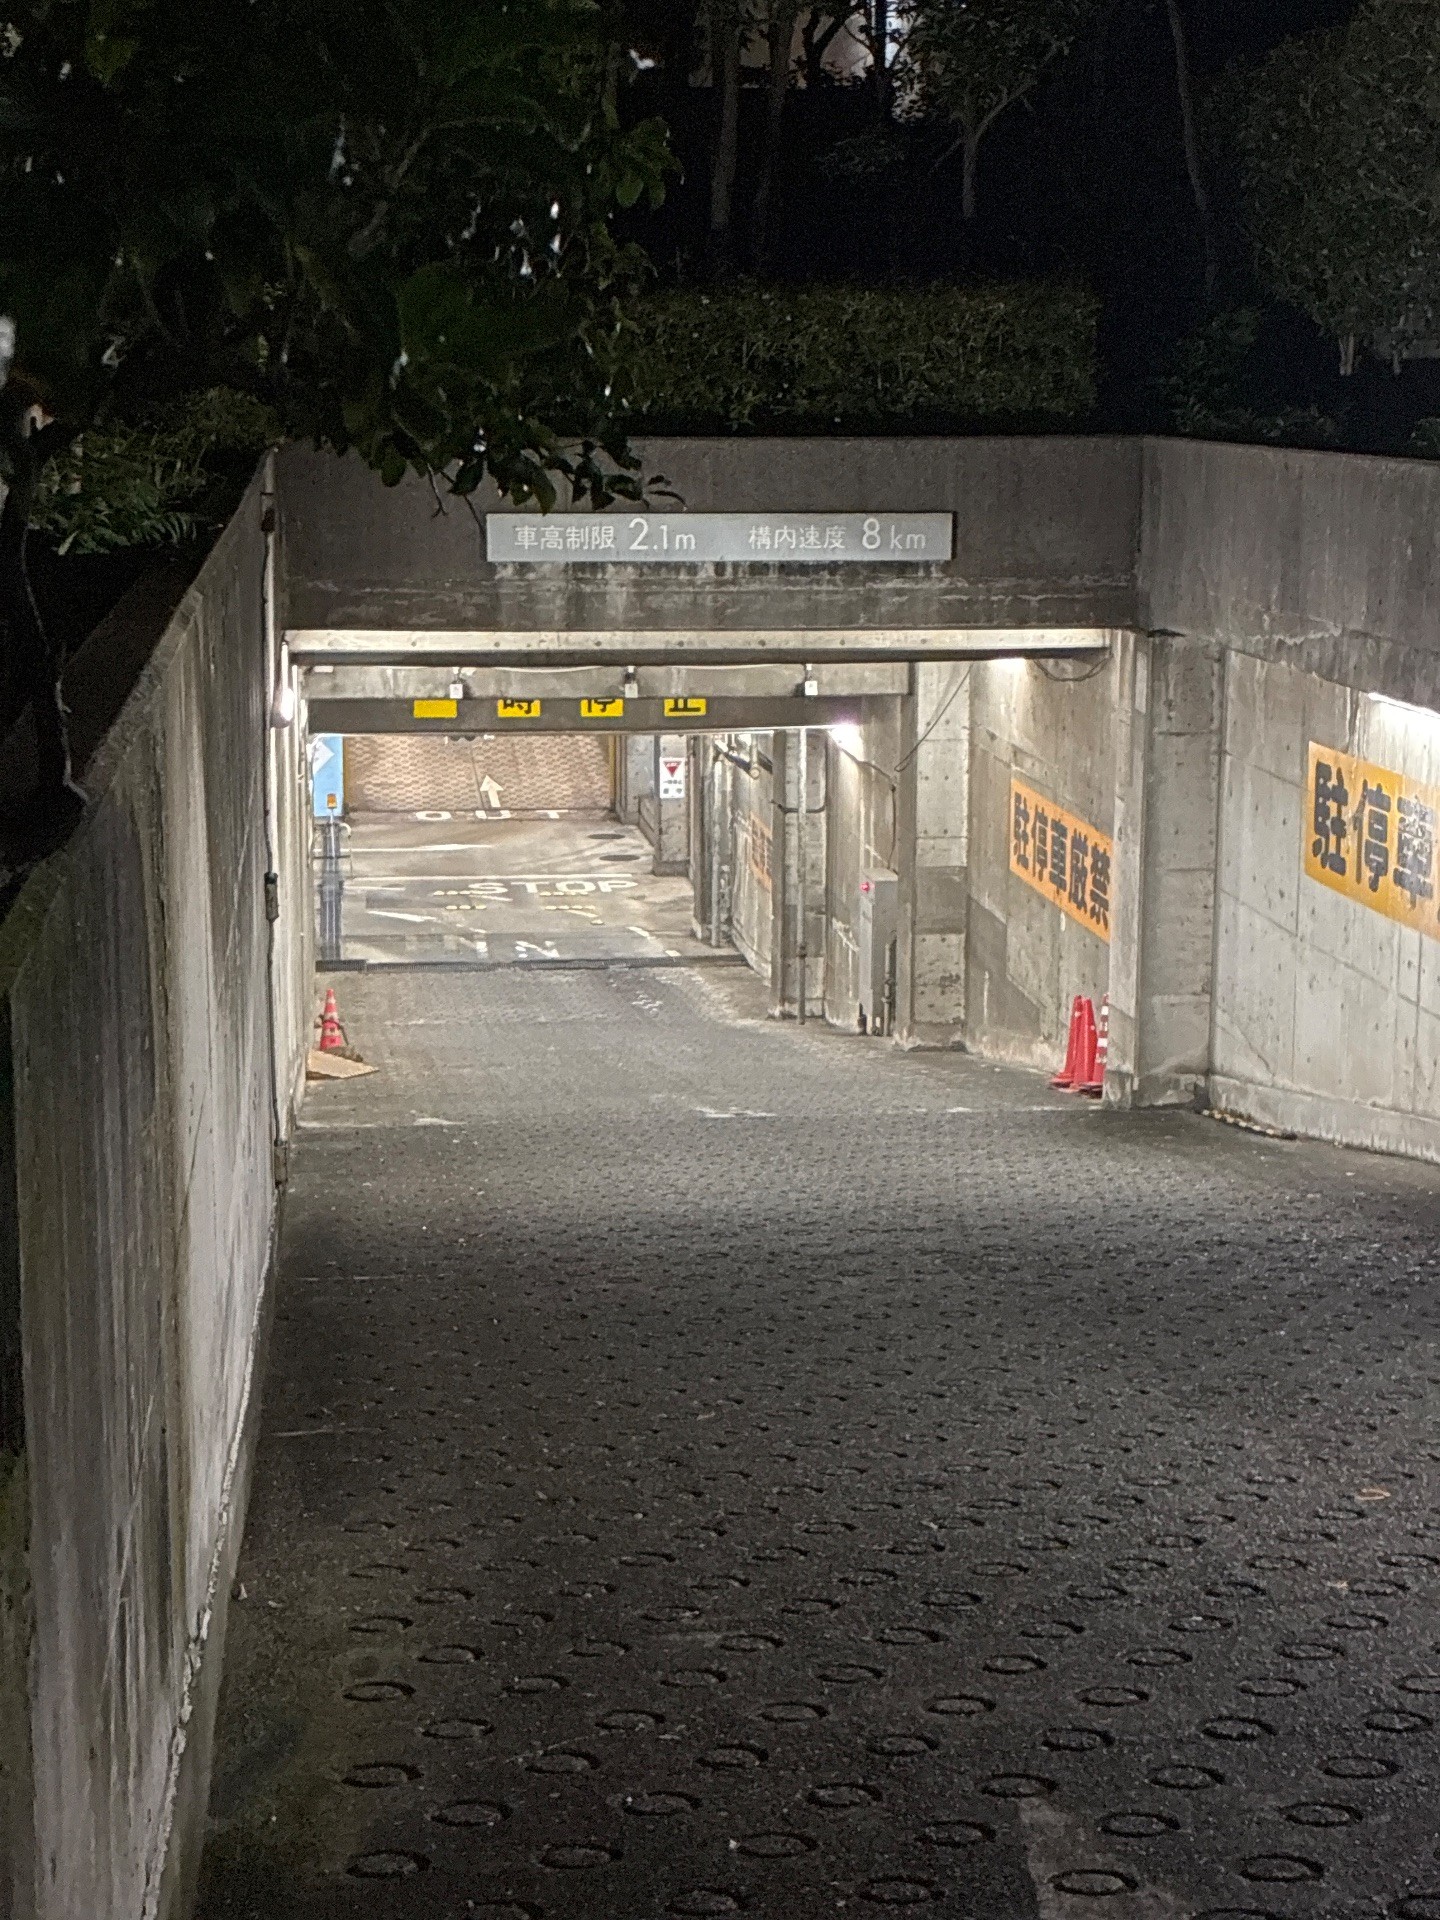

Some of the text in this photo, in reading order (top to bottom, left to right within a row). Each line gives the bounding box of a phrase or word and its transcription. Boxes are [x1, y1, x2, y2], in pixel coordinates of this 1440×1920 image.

[514, 525, 615, 550] 車高制限
[749, 525, 847, 550] 構内速度
[415, 809, 569, 820] OUT
[1312, 760, 1440, 927] 駐停車
[1013, 791, 1110, 930] 駐停車厳禁
[468, 880, 639, 895] STOP
